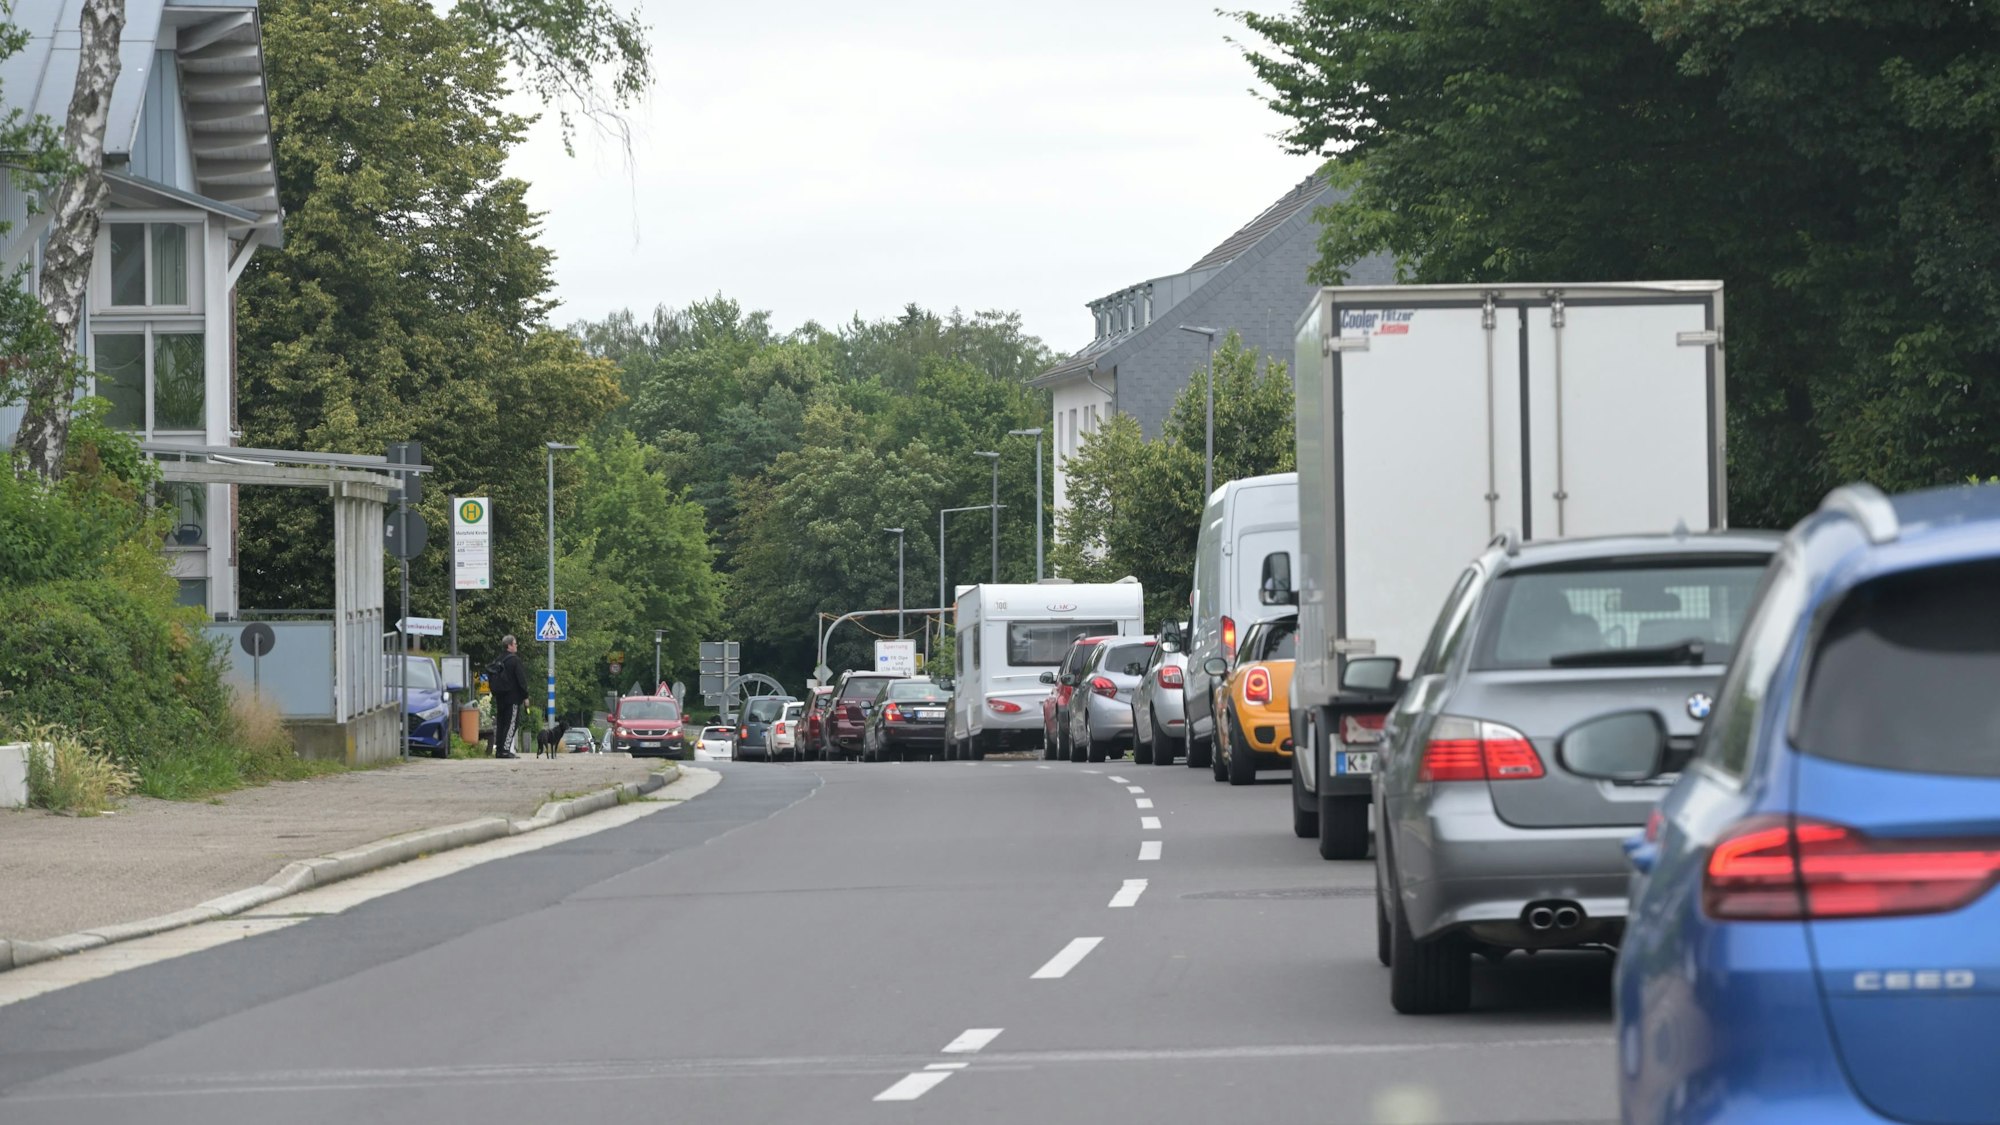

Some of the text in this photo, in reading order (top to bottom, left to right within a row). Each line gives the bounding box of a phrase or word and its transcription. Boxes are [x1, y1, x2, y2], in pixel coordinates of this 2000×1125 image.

[1341, 308, 1379, 329] Cooler
[466, 504, 477, 519] H
[996, 601, 1007, 610] 100
[1347, 754, 1359, 771] K
[1854, 969, 1976, 990] CEED
